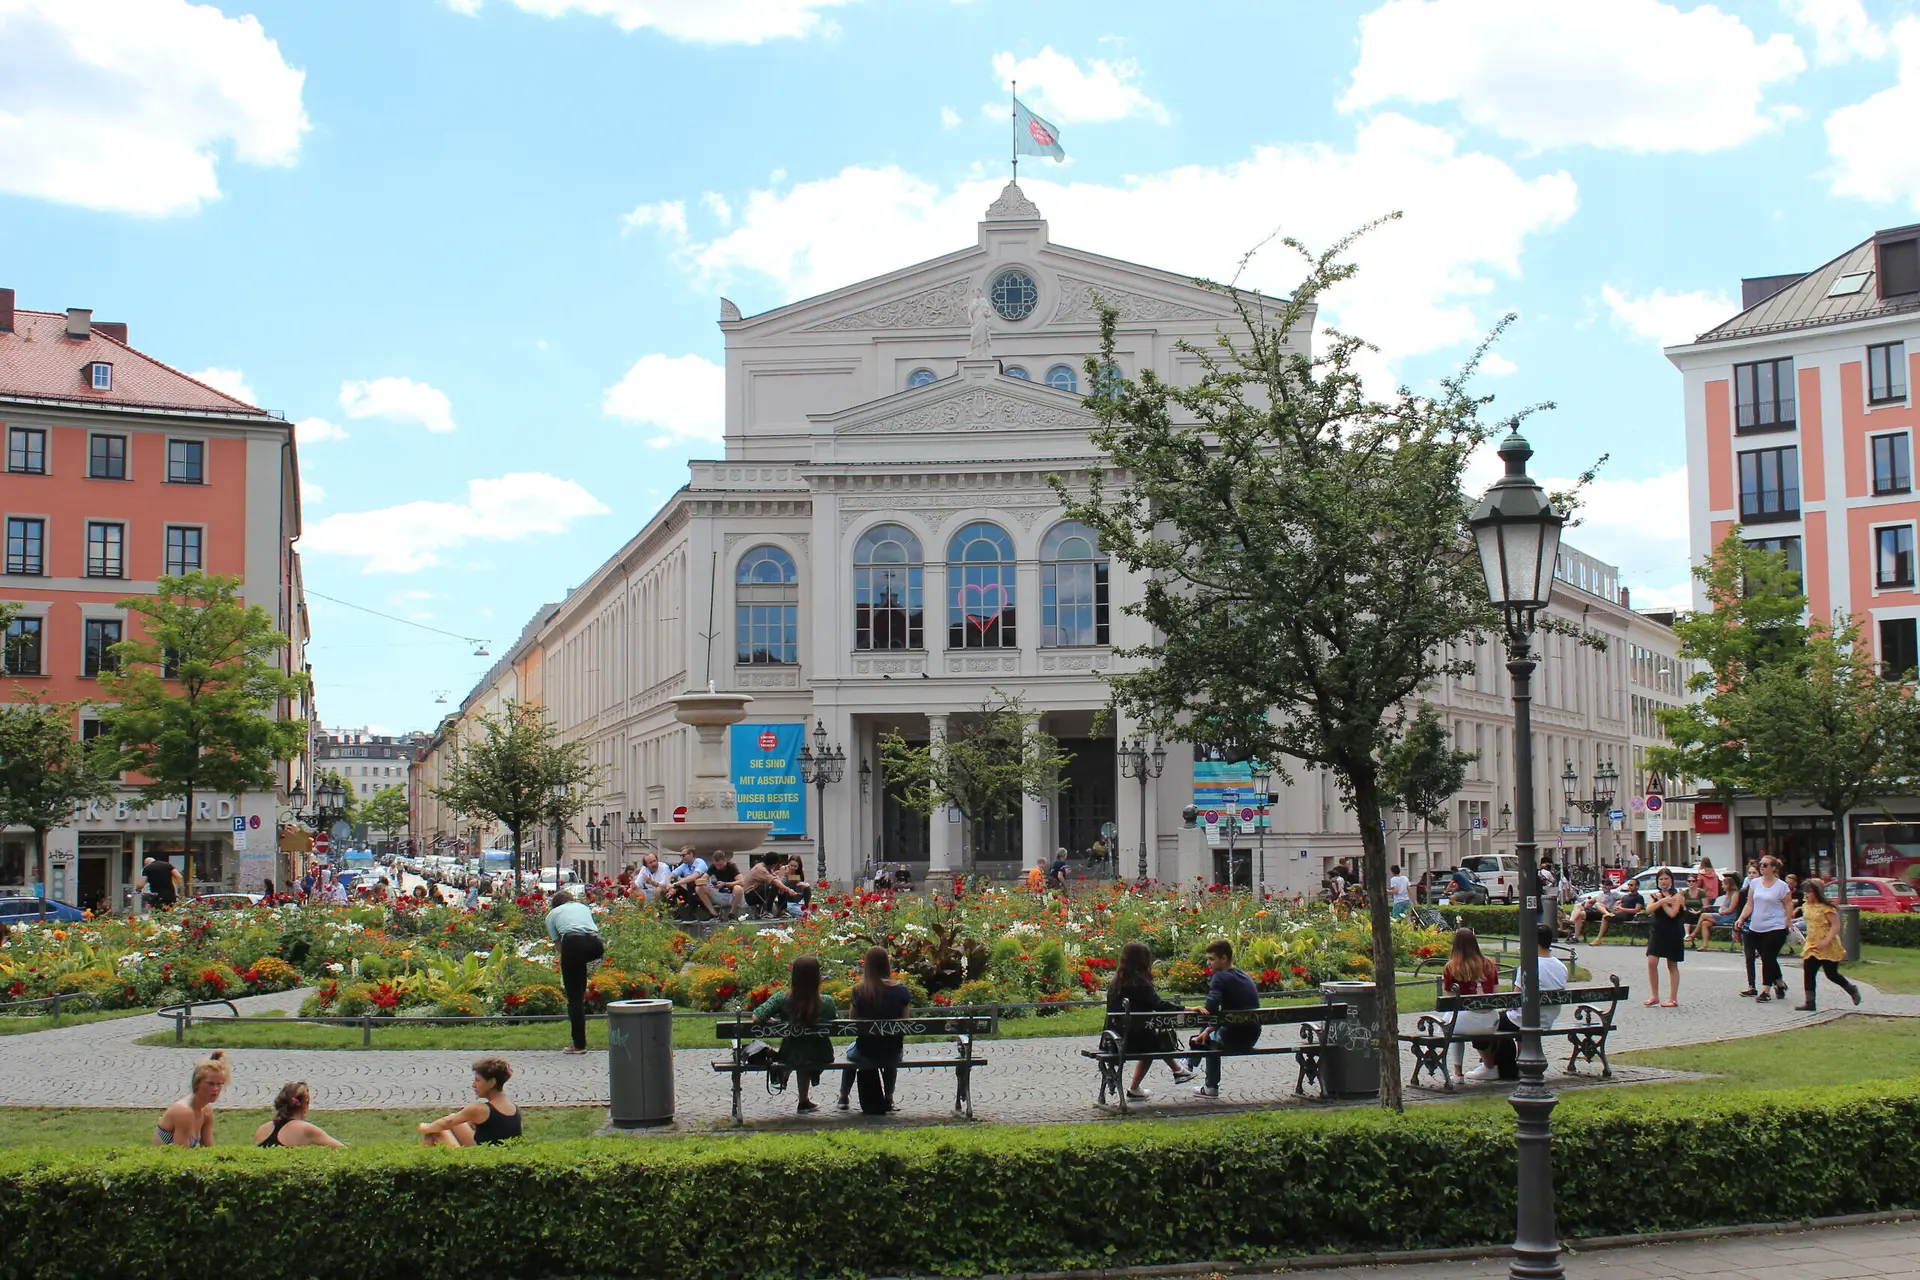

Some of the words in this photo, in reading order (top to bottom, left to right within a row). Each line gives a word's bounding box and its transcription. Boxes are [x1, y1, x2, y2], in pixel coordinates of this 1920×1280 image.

[750, 759, 763, 768] SIE
[765, 759, 786, 768] SIND
[740, 776, 755, 785] MIT
[757, 776, 796, 785] ABSTAND
[737, 794, 765, 803] UNSER
[767, 793, 799, 803] BESTES
[746, 810, 790, 820] PUBLIKUM
